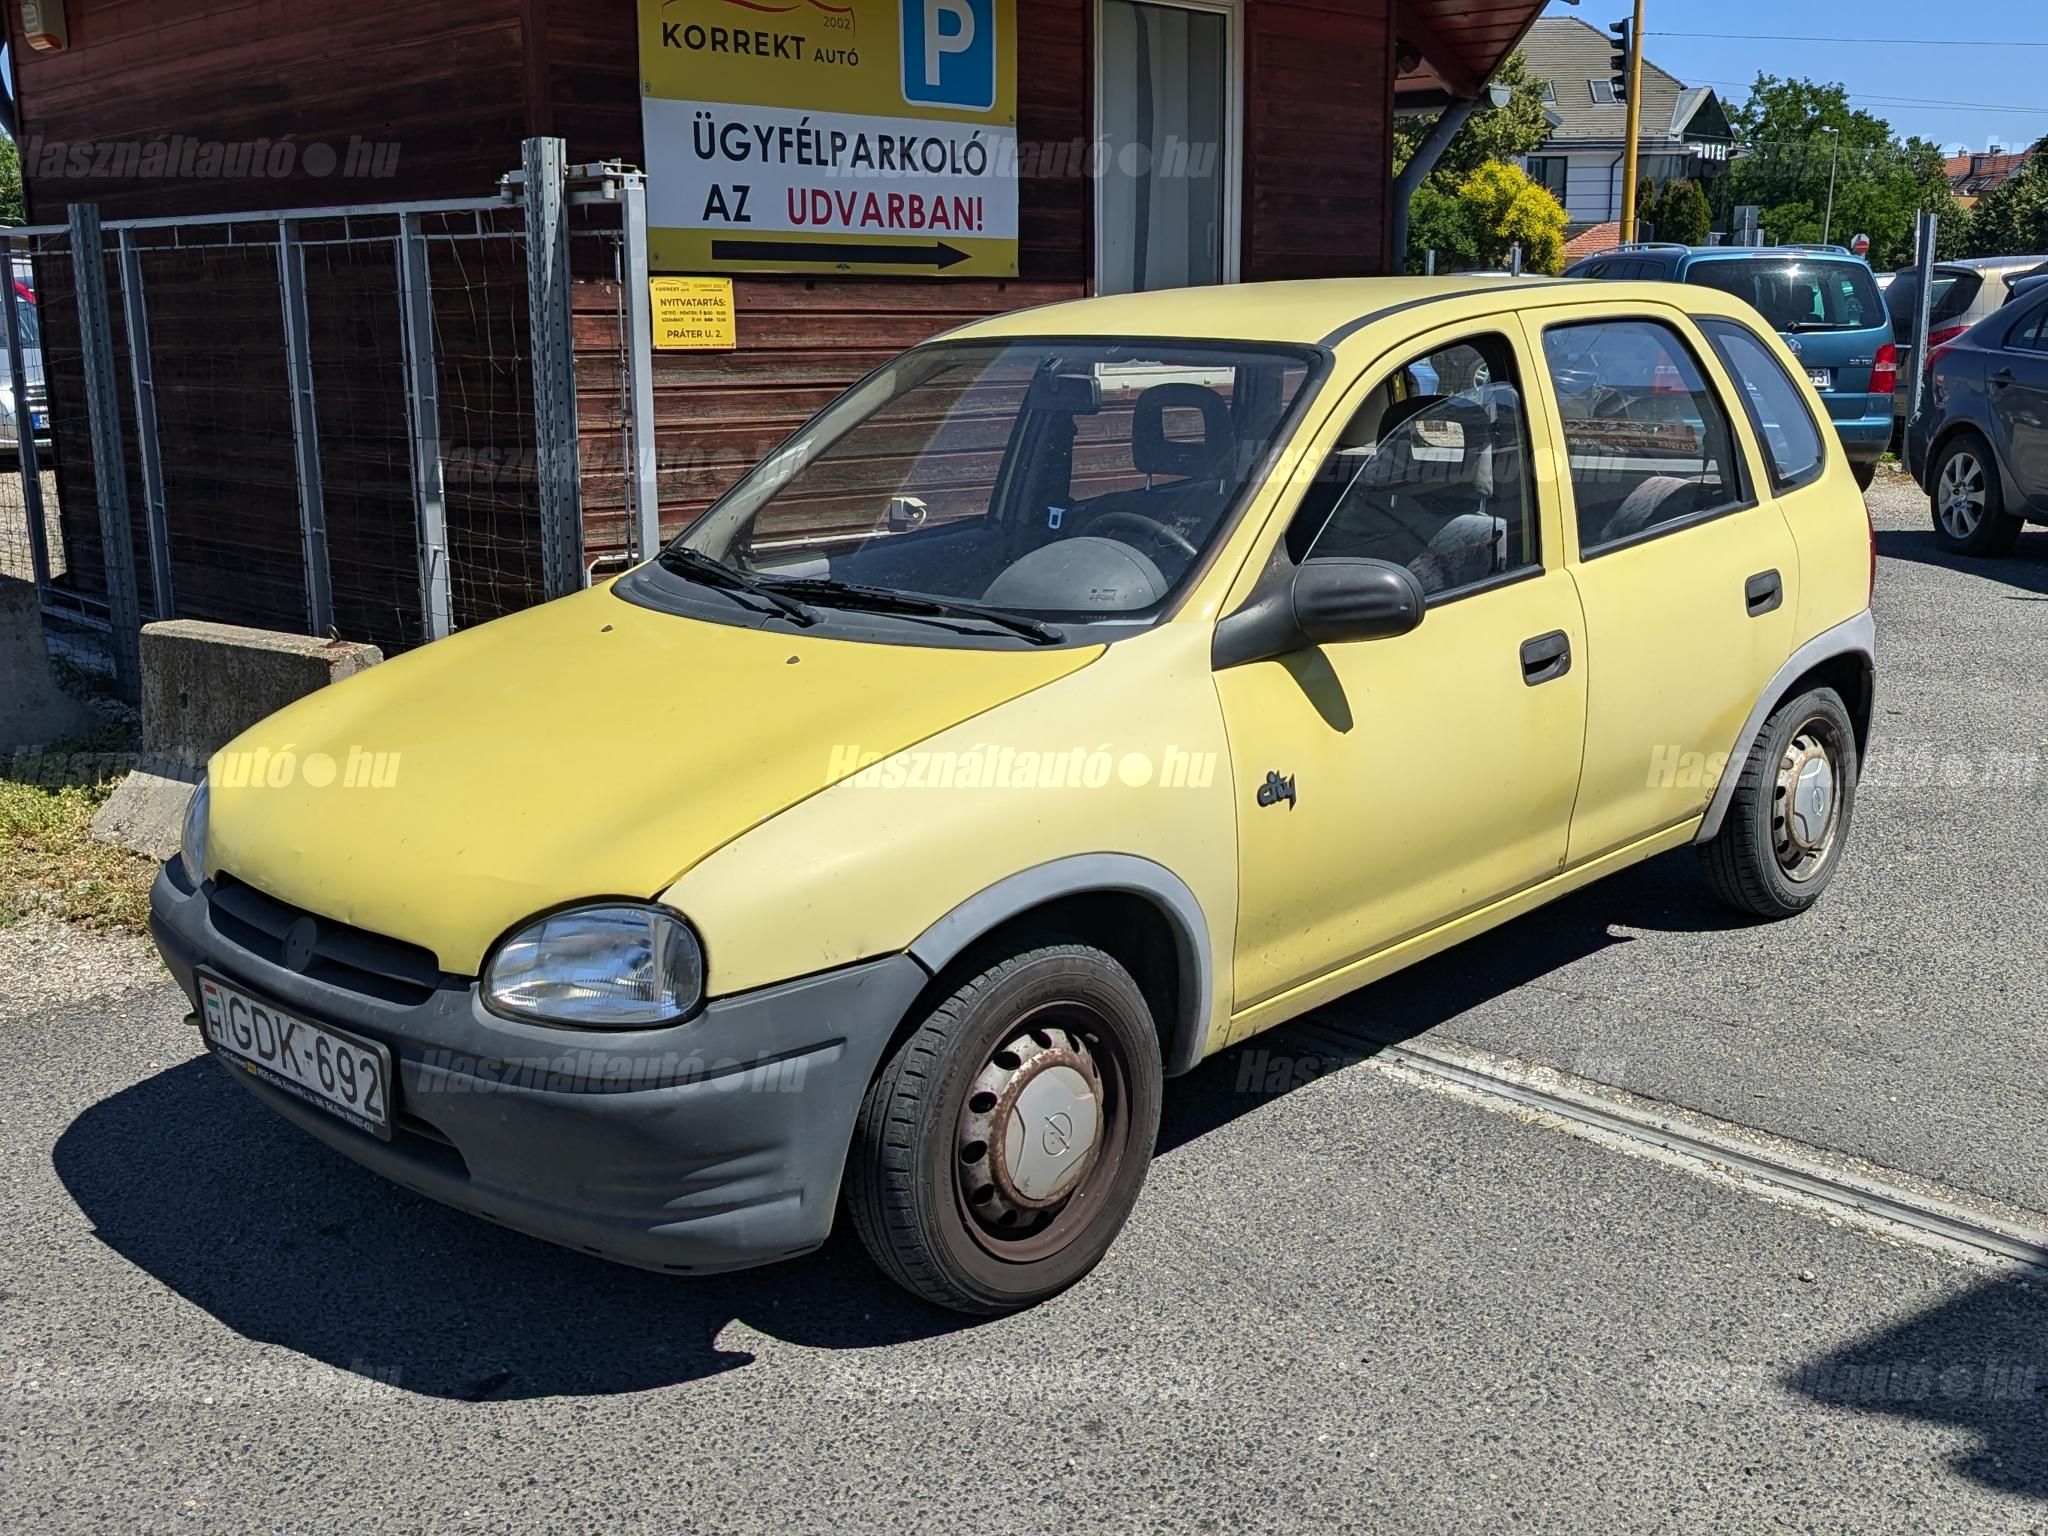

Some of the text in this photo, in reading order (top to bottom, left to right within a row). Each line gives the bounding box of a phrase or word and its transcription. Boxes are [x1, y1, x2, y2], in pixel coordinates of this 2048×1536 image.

[662, 22, 859, 66] KORREKT AUTÓ
[823, 16, 850, 30] 2002
[924, 0, 975, 86] P
[693, 111, 987, 176] ÜGYFÉLPARKOLÓ
[702, 184, 983, 232] AZ UDVARBAN!
[660, 296, 727, 308] NYITVATARTÁS:
[667, 328, 703, 339] PRÁTER
[208, 1011, 223, 1039] H
[229, 996, 383, 1118] GDK-692
